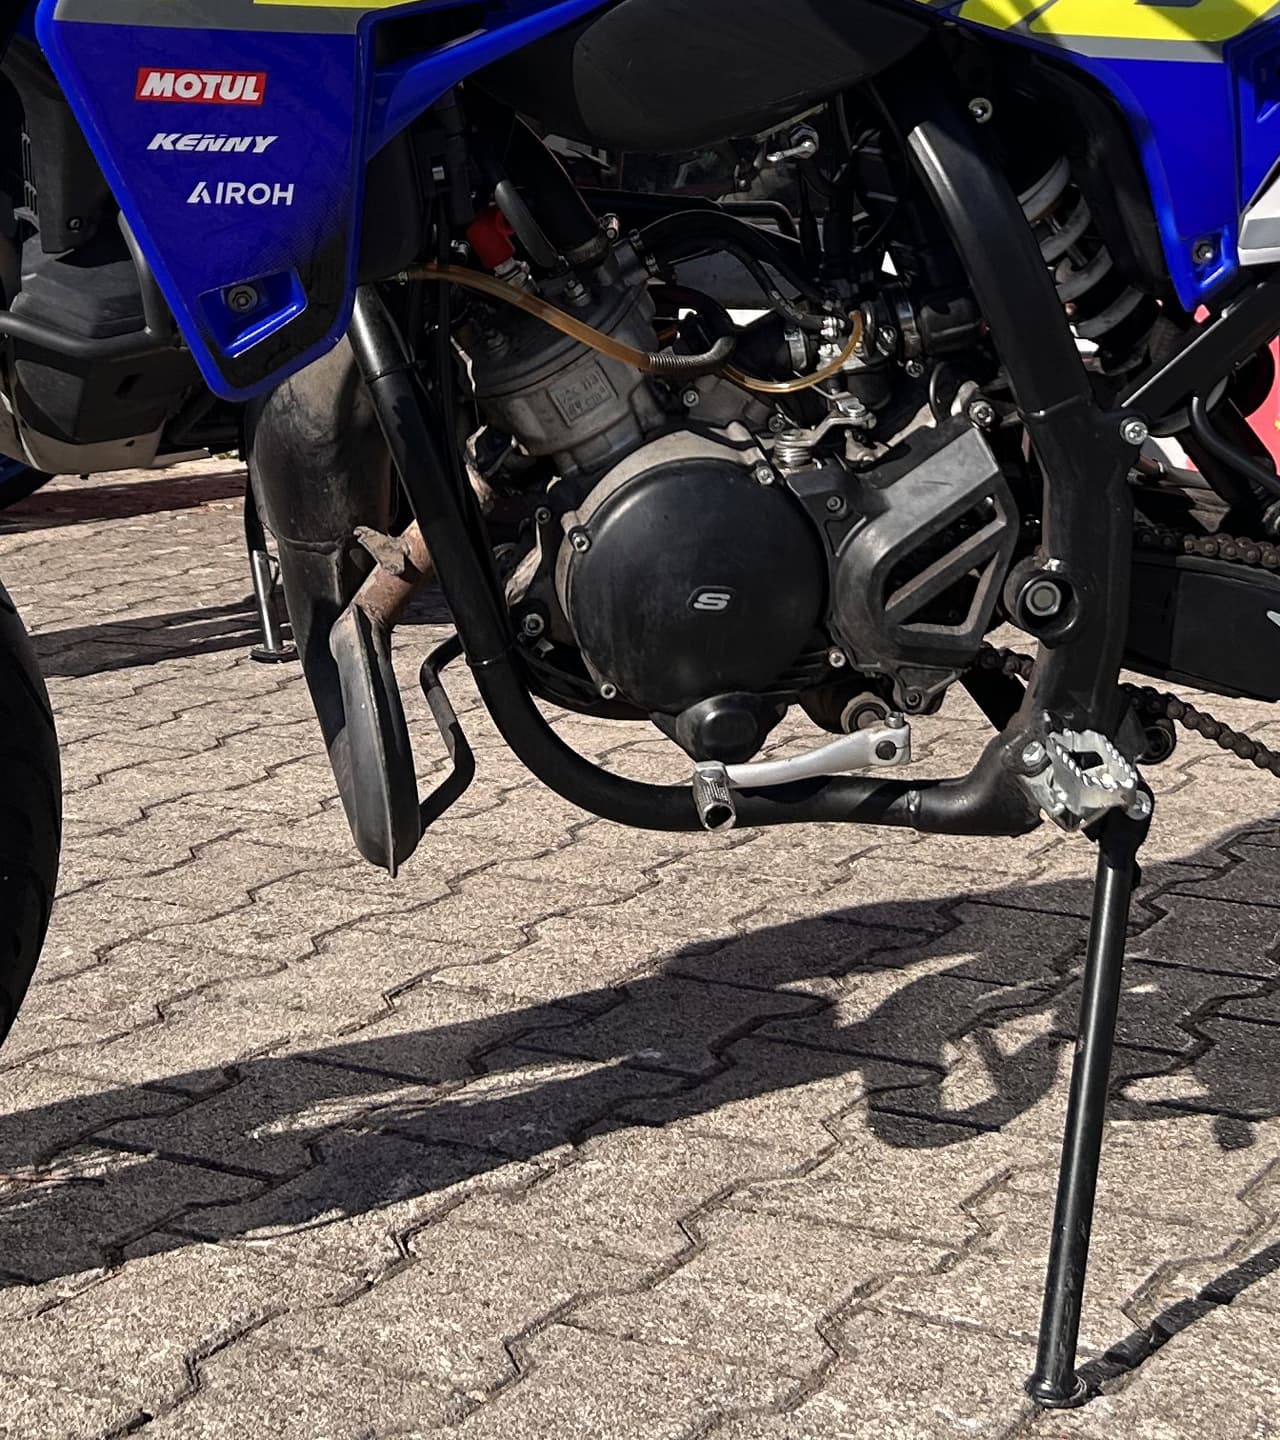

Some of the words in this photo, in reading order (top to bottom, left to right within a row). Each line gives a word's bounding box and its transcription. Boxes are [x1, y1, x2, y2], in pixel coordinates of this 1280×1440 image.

[140, 71, 261, 102] MOTUL
[147, 132, 279, 154] KENNY
[187, 181, 295, 207] AIROH
